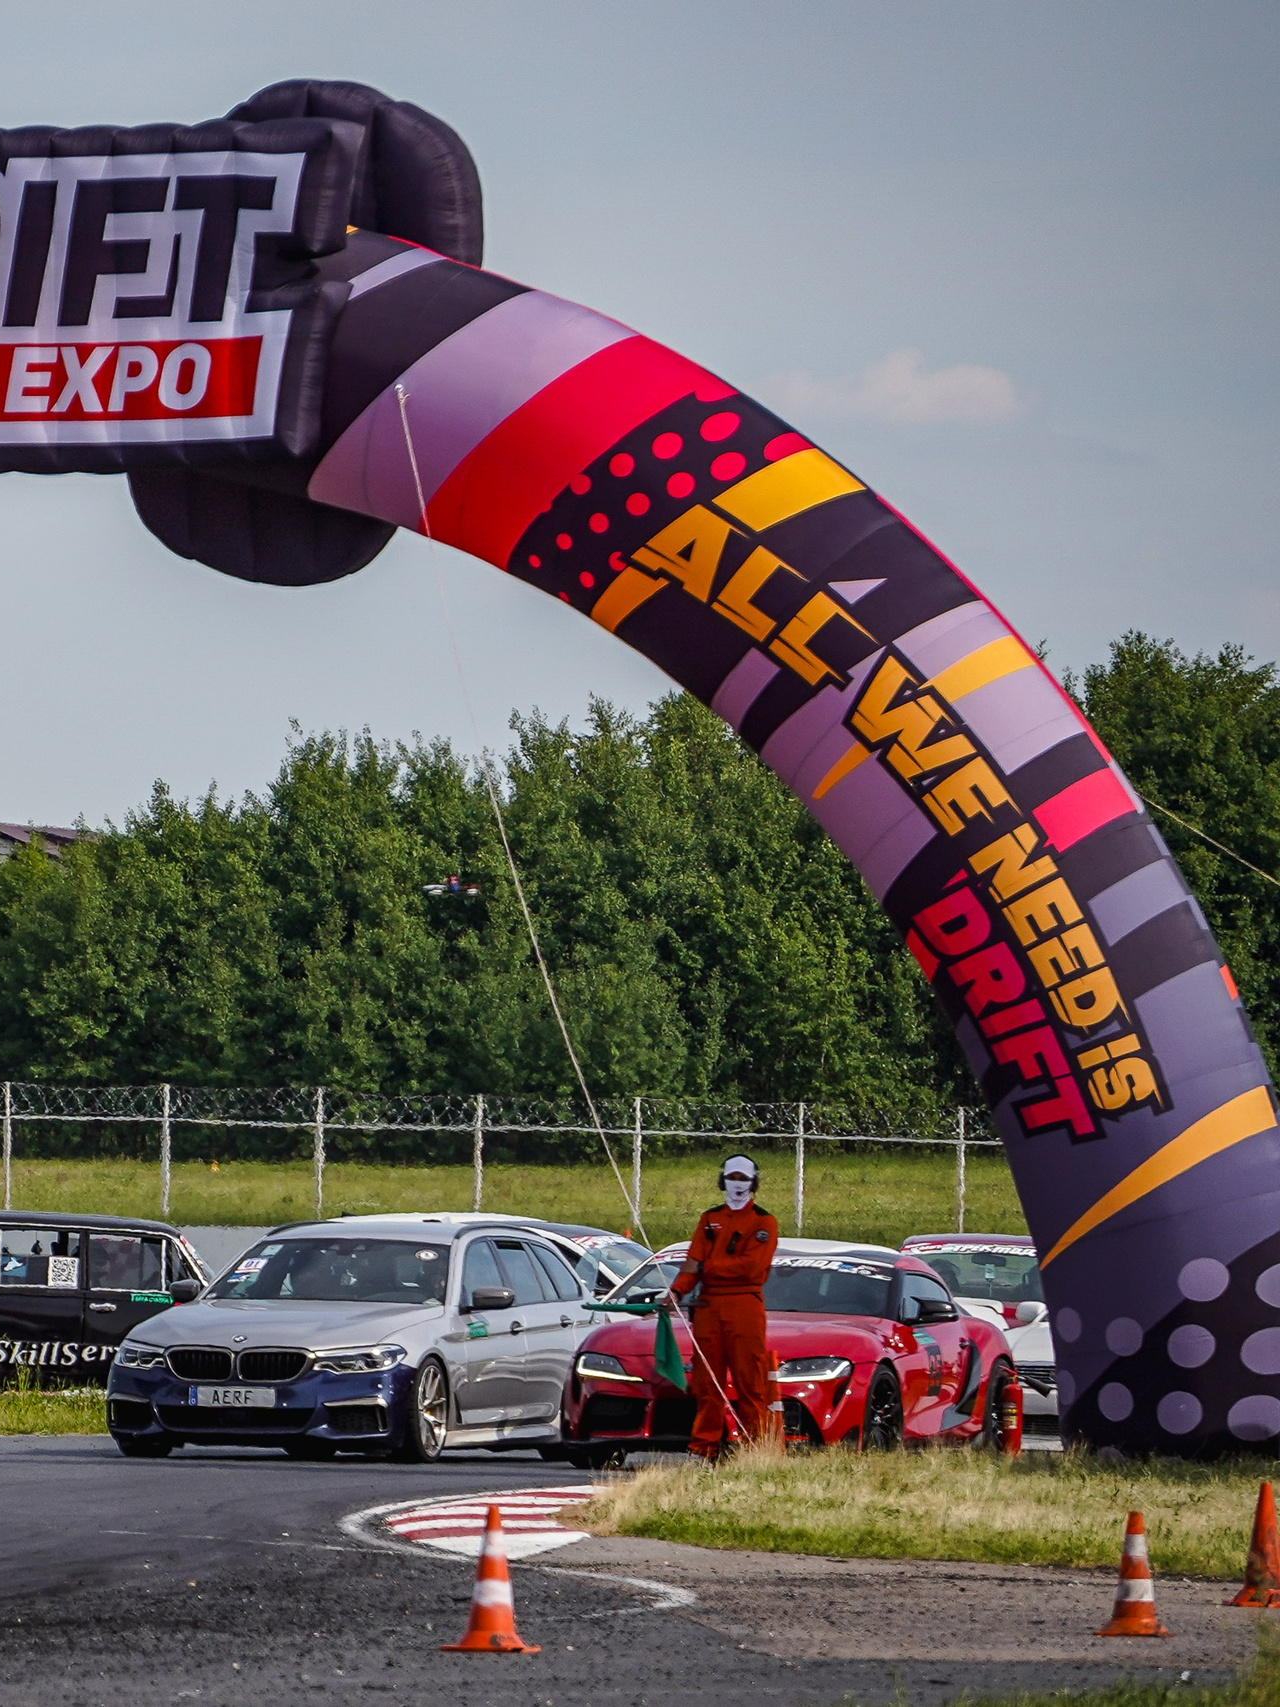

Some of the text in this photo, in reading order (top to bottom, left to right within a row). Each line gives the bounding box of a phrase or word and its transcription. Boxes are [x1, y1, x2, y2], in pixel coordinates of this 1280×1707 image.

[3, 343, 211, 414] EXPO
[630, 504, 878, 687] ALL
[851, 655, 1019, 837] WE
[967, 822, 1129, 1034] NEED
[913, 880, 1096, 1136] DRIFT
[212, 1389, 255, 1406] AERF
